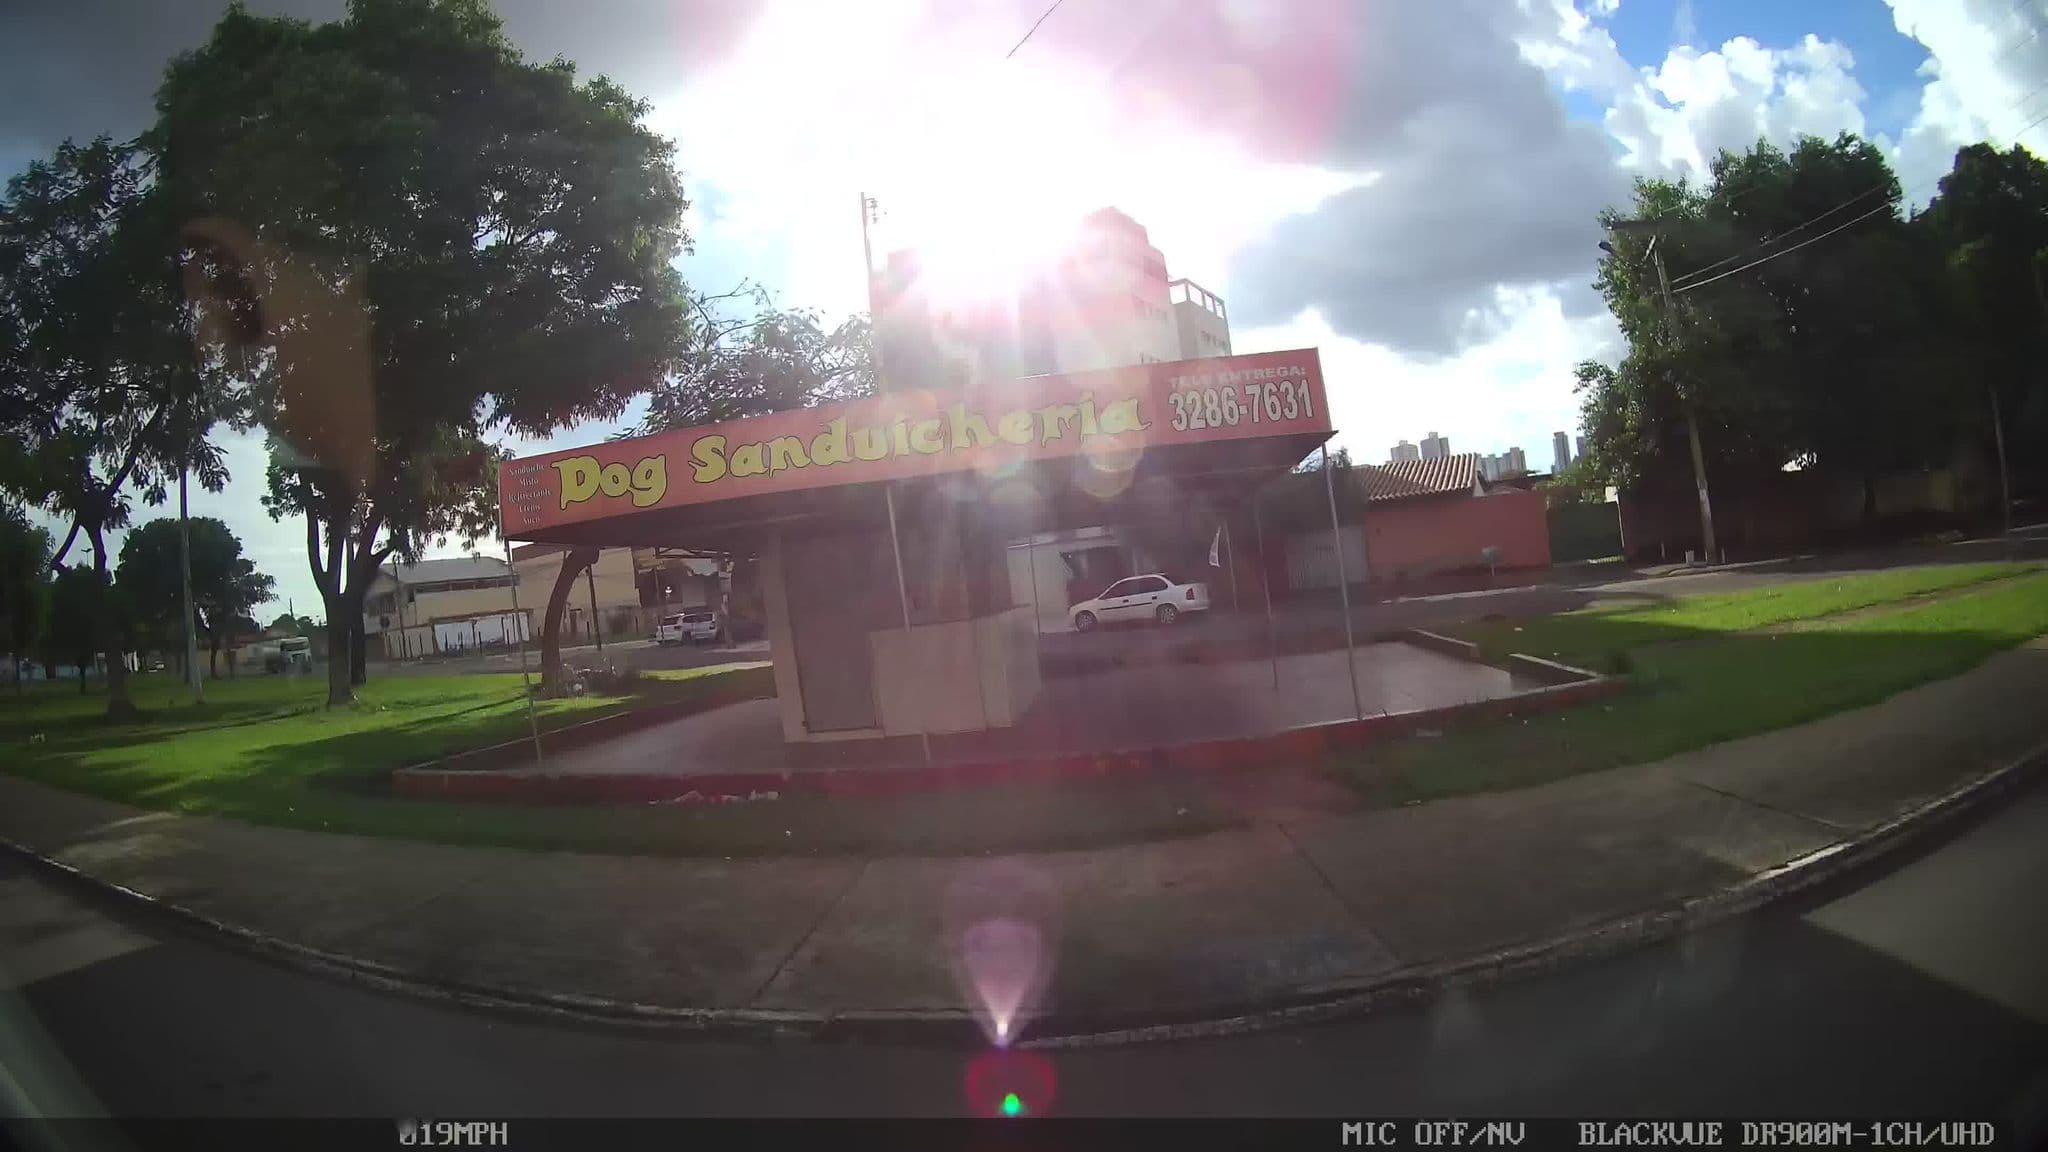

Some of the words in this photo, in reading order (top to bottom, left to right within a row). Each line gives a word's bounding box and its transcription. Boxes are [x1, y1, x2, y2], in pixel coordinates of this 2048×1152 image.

[1217, 365, 1307, 385] ENTREGA:
[1168, 379, 1315, 432] 3286-7631
[550, 453, 669, 511] Dog
[688, 390, 1153, 484] Sanduicheria
